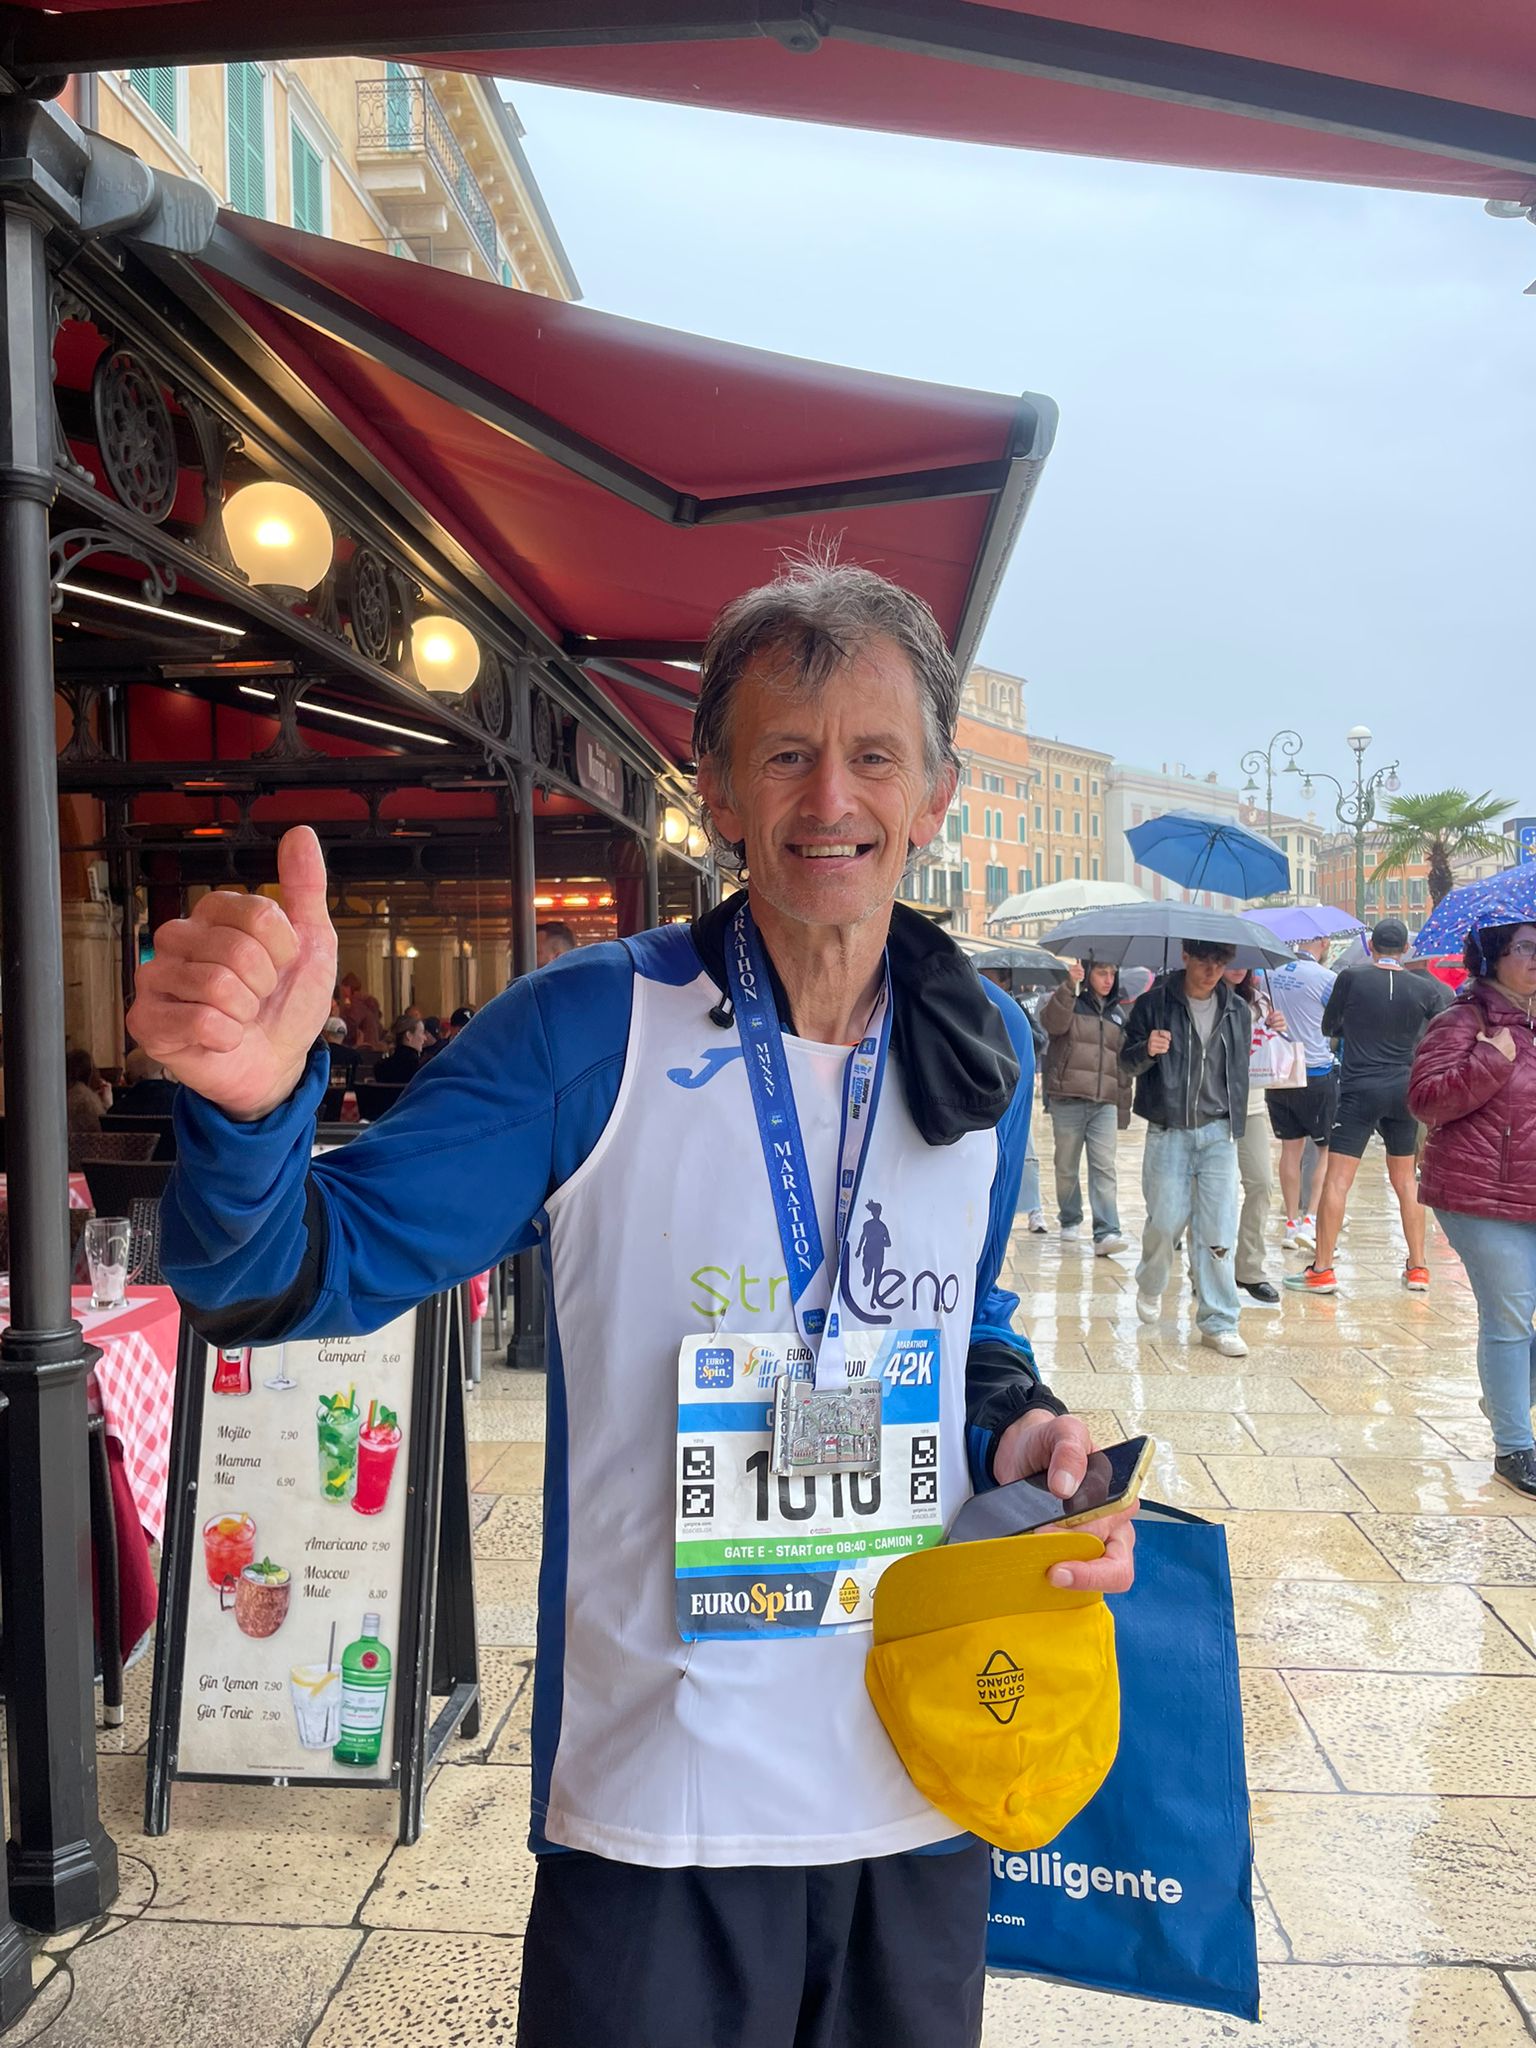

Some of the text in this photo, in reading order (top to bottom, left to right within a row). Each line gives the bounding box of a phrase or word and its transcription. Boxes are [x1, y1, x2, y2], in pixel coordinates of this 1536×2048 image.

[756, 1042, 775, 1097] MMXXV
[773, 1141, 812, 1273] MARATHON
[896, 1340, 928, 1349] MARATHON
[317, 1349, 367, 1366] Campari
[705, 1357, 725, 1366] EURO
[702, 1366, 726, 1380] Spin
[786, 1362, 816, 1380] VER
[883, 1351, 935, 1386] 42K
[217, 1425, 252, 1442] Mojito
[214, 1453, 262, 1468] Mamma
[213, 1471, 236, 1485] Mia
[304, 1536, 368, 1551] Americano
[724, 1547, 754, 1559] GATE
[758, 1546, 765, 1558] E
[776, 1544, 813, 1557] START
[815, 1545, 833, 1555] ore
[837, 1540, 866, 1553] 08:40
[875, 1535, 912, 1550] CAMION
[917, 1534, 924, 1545] 2
[304, 1565, 350, 1580] Moscow
[303, 1584, 332, 1598] Mule
[199, 1674, 218, 1692] Gin
[222, 1675, 259, 1693] Lemon
[976, 1672, 1025, 1688] PADANO
[978, 1684, 1025, 1700] GRANA
[197, 1703, 217, 1721] Gin
[220, 1704, 254, 1720] Tonic
